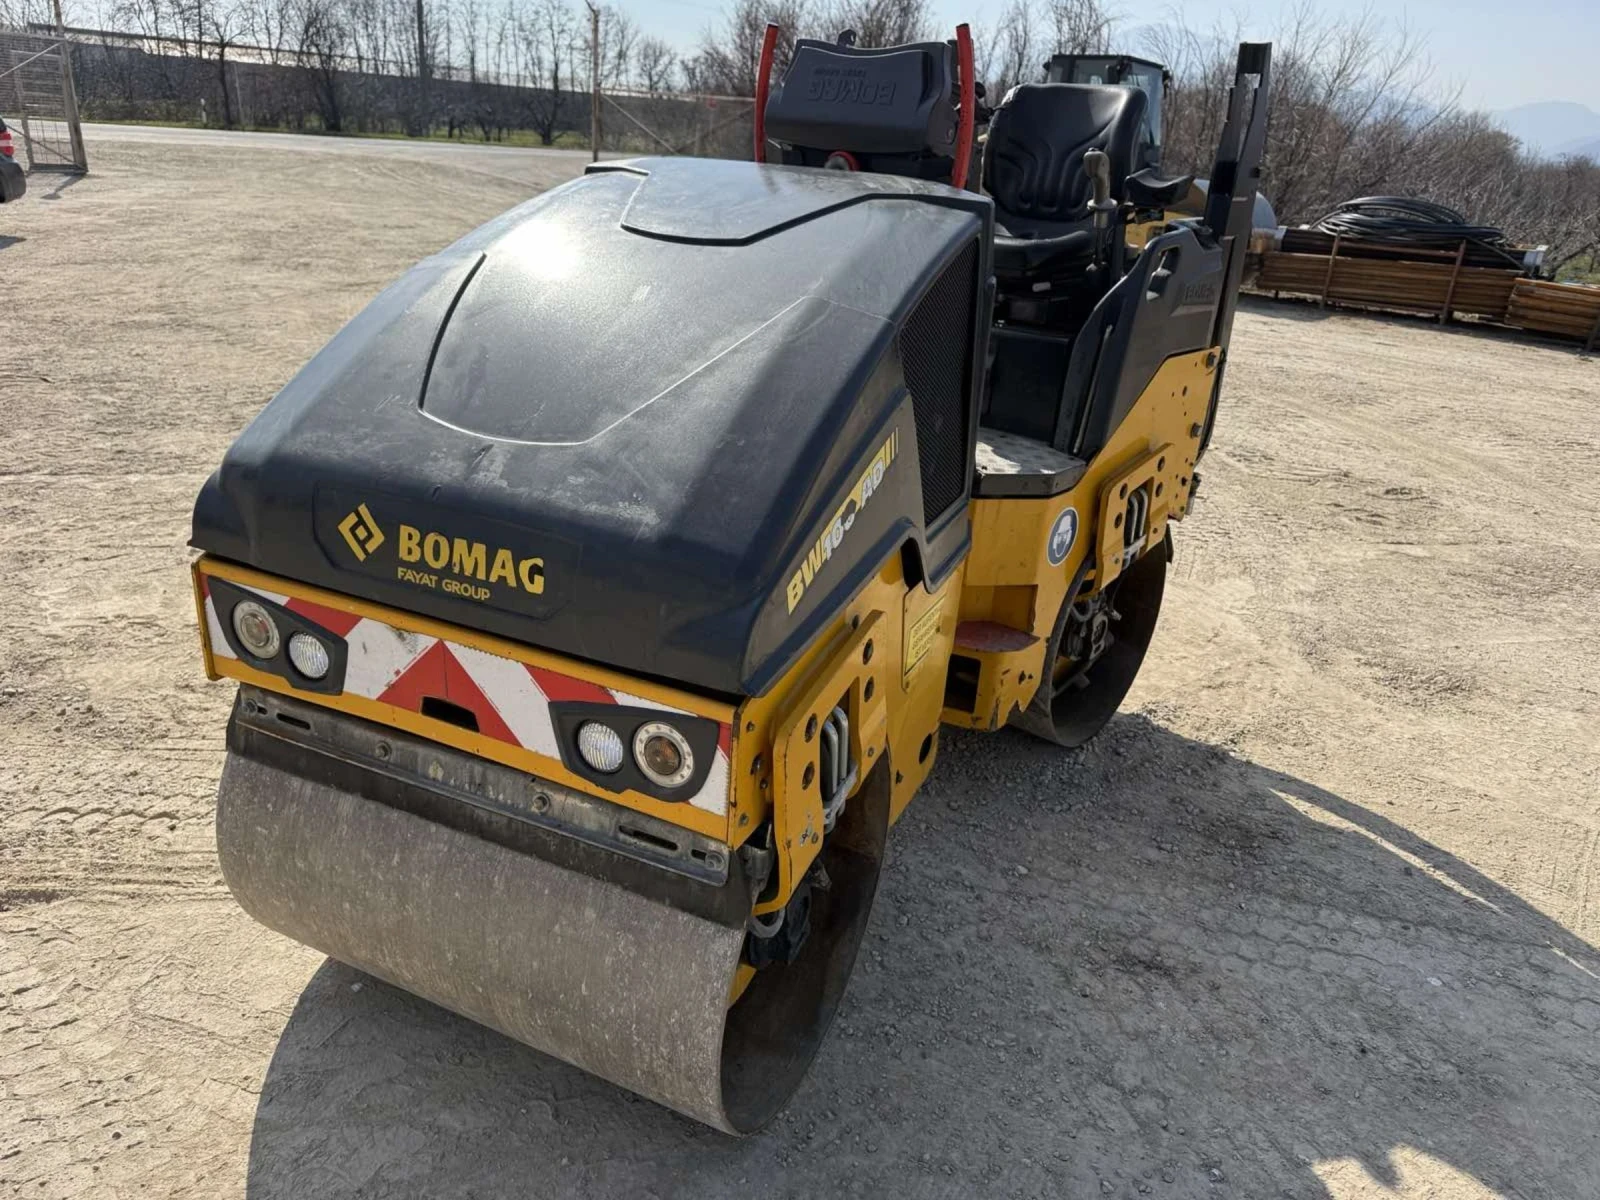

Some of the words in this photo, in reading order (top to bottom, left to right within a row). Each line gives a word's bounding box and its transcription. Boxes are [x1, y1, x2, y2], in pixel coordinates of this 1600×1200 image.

[397, 567, 438, 588] FAYAT
[442, 579, 490, 601] GROUP
[399, 524, 545, 595] BOMAG
